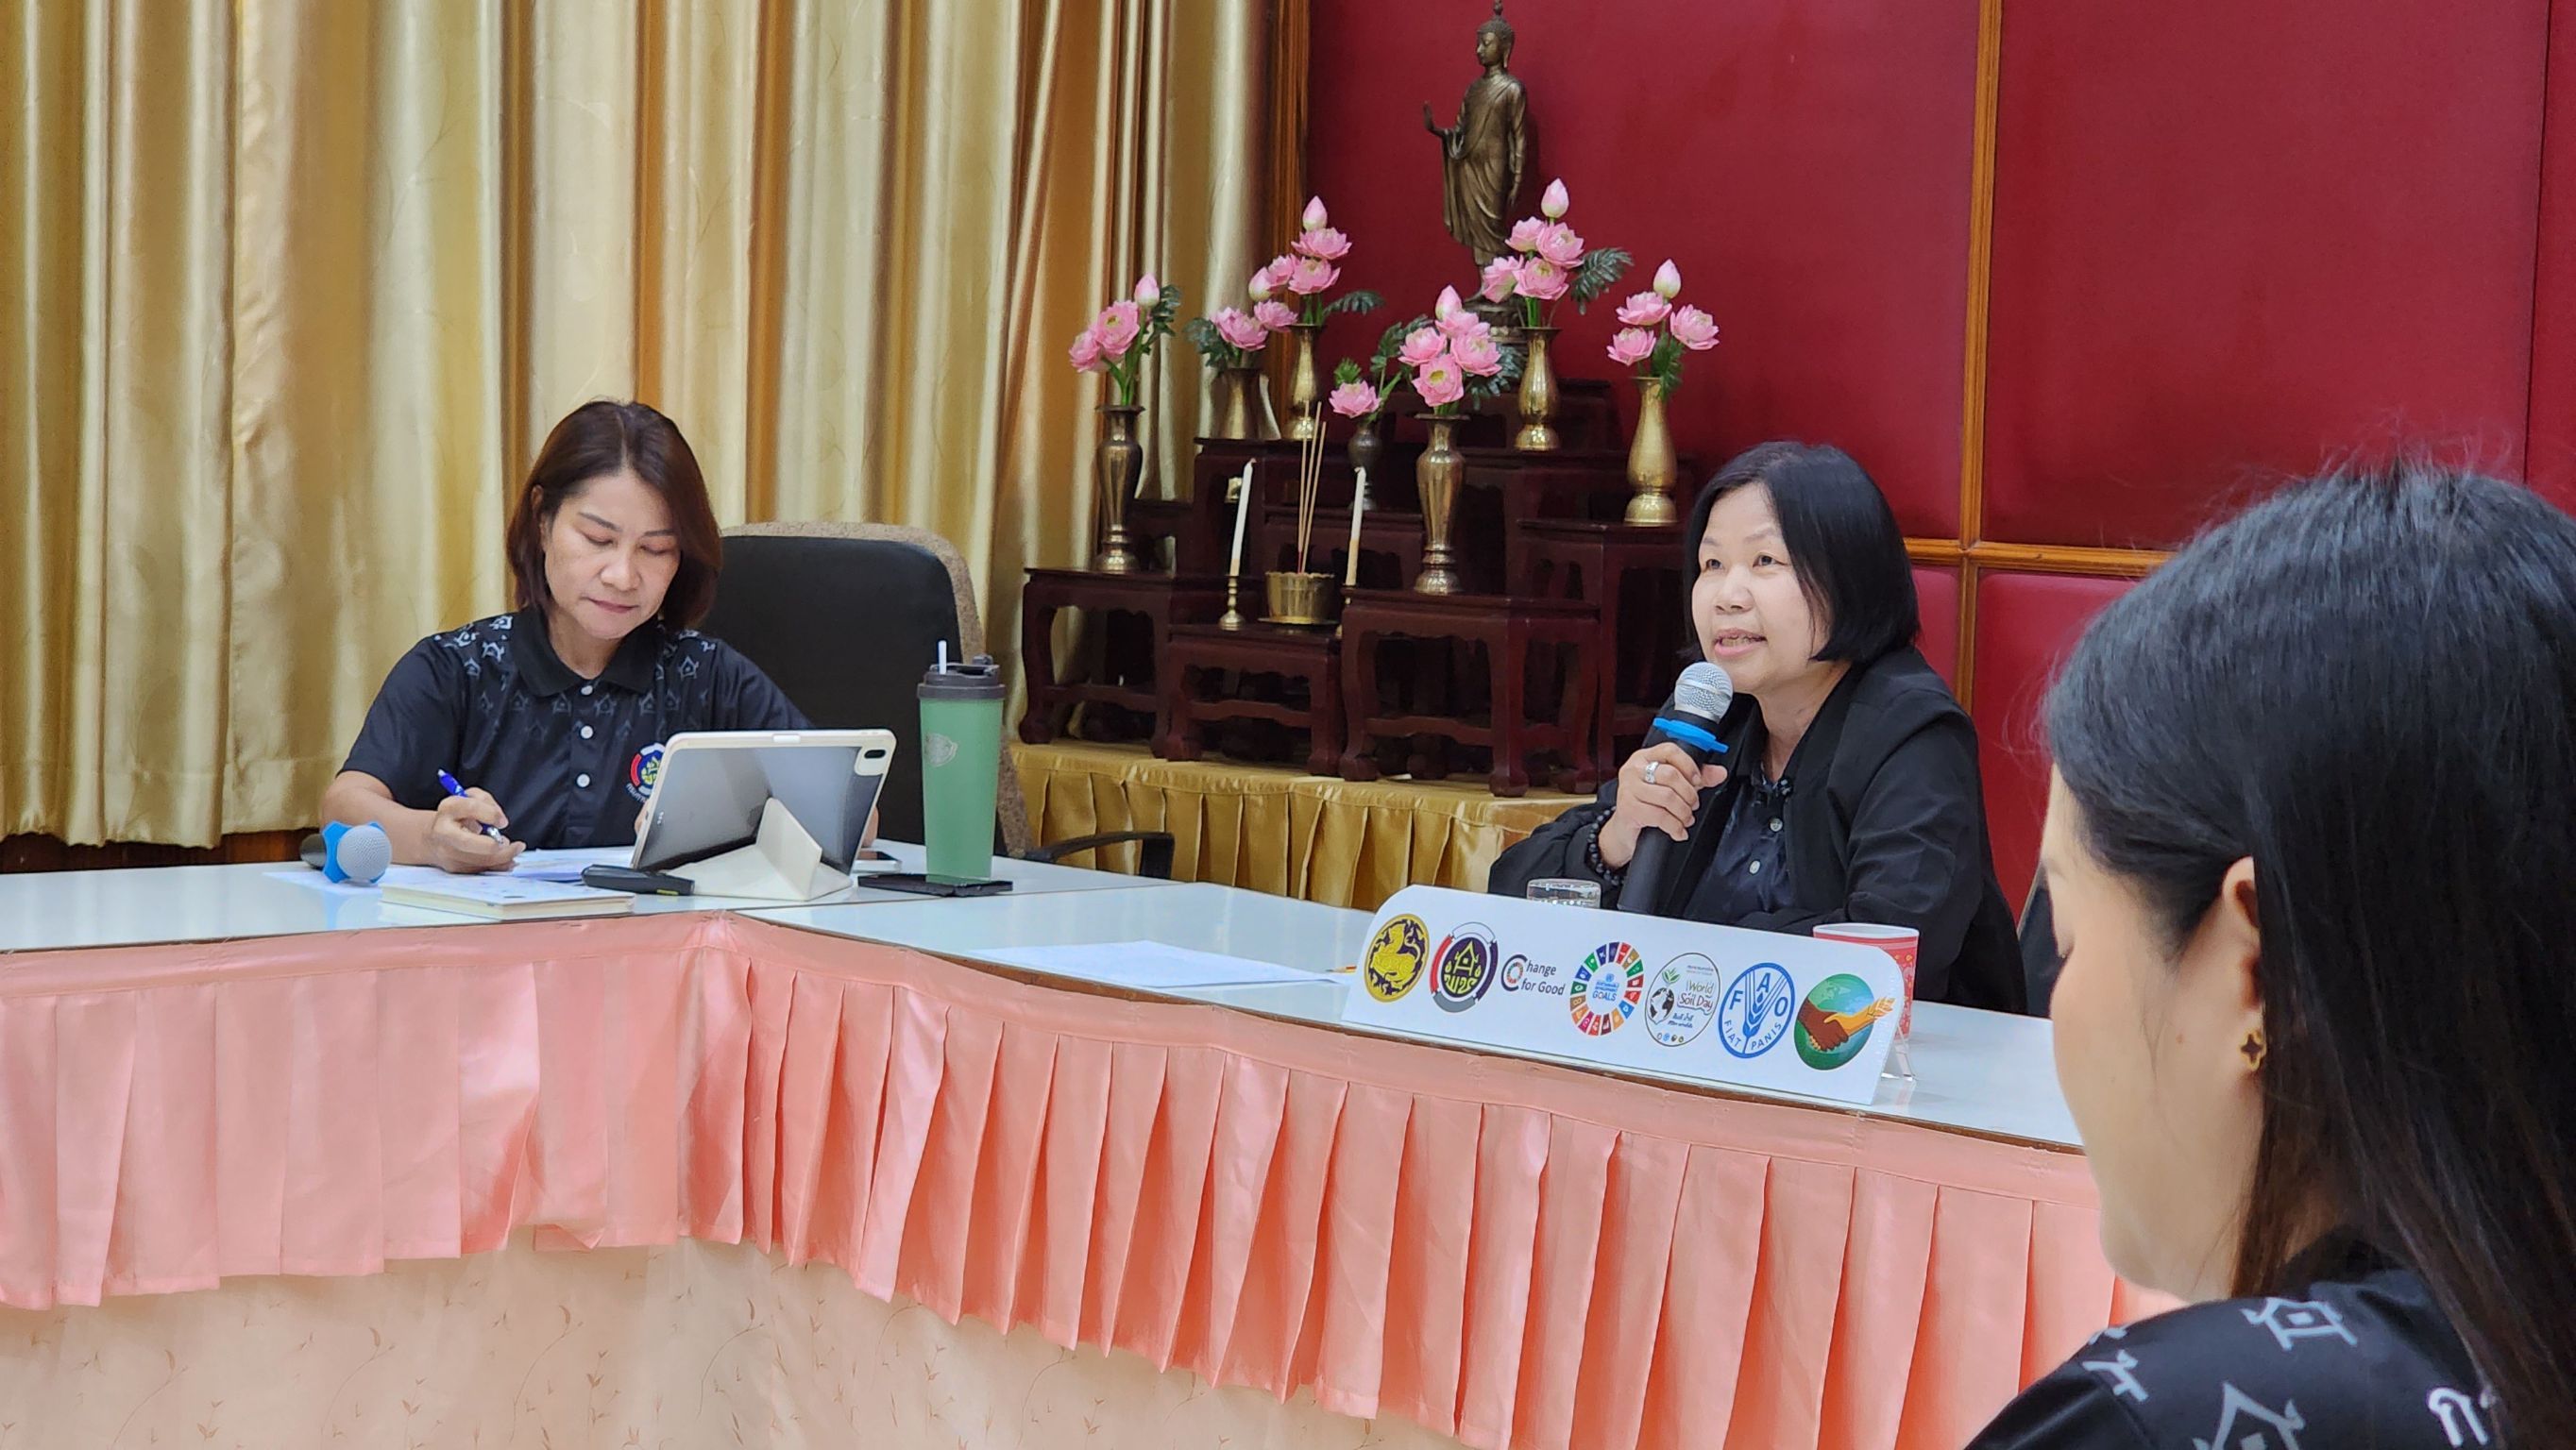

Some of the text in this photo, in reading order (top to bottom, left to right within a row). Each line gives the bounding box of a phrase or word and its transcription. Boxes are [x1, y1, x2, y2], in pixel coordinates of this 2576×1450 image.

[1521, 978, 1566, 995] for Good
[1689, 979, 1714, 994] World
[1592, 990, 1617, 1002] GOALS
[1680, 992, 1713, 1011] Soil Day
[1724, 1020, 1782, 1050] FIAT PANIS
